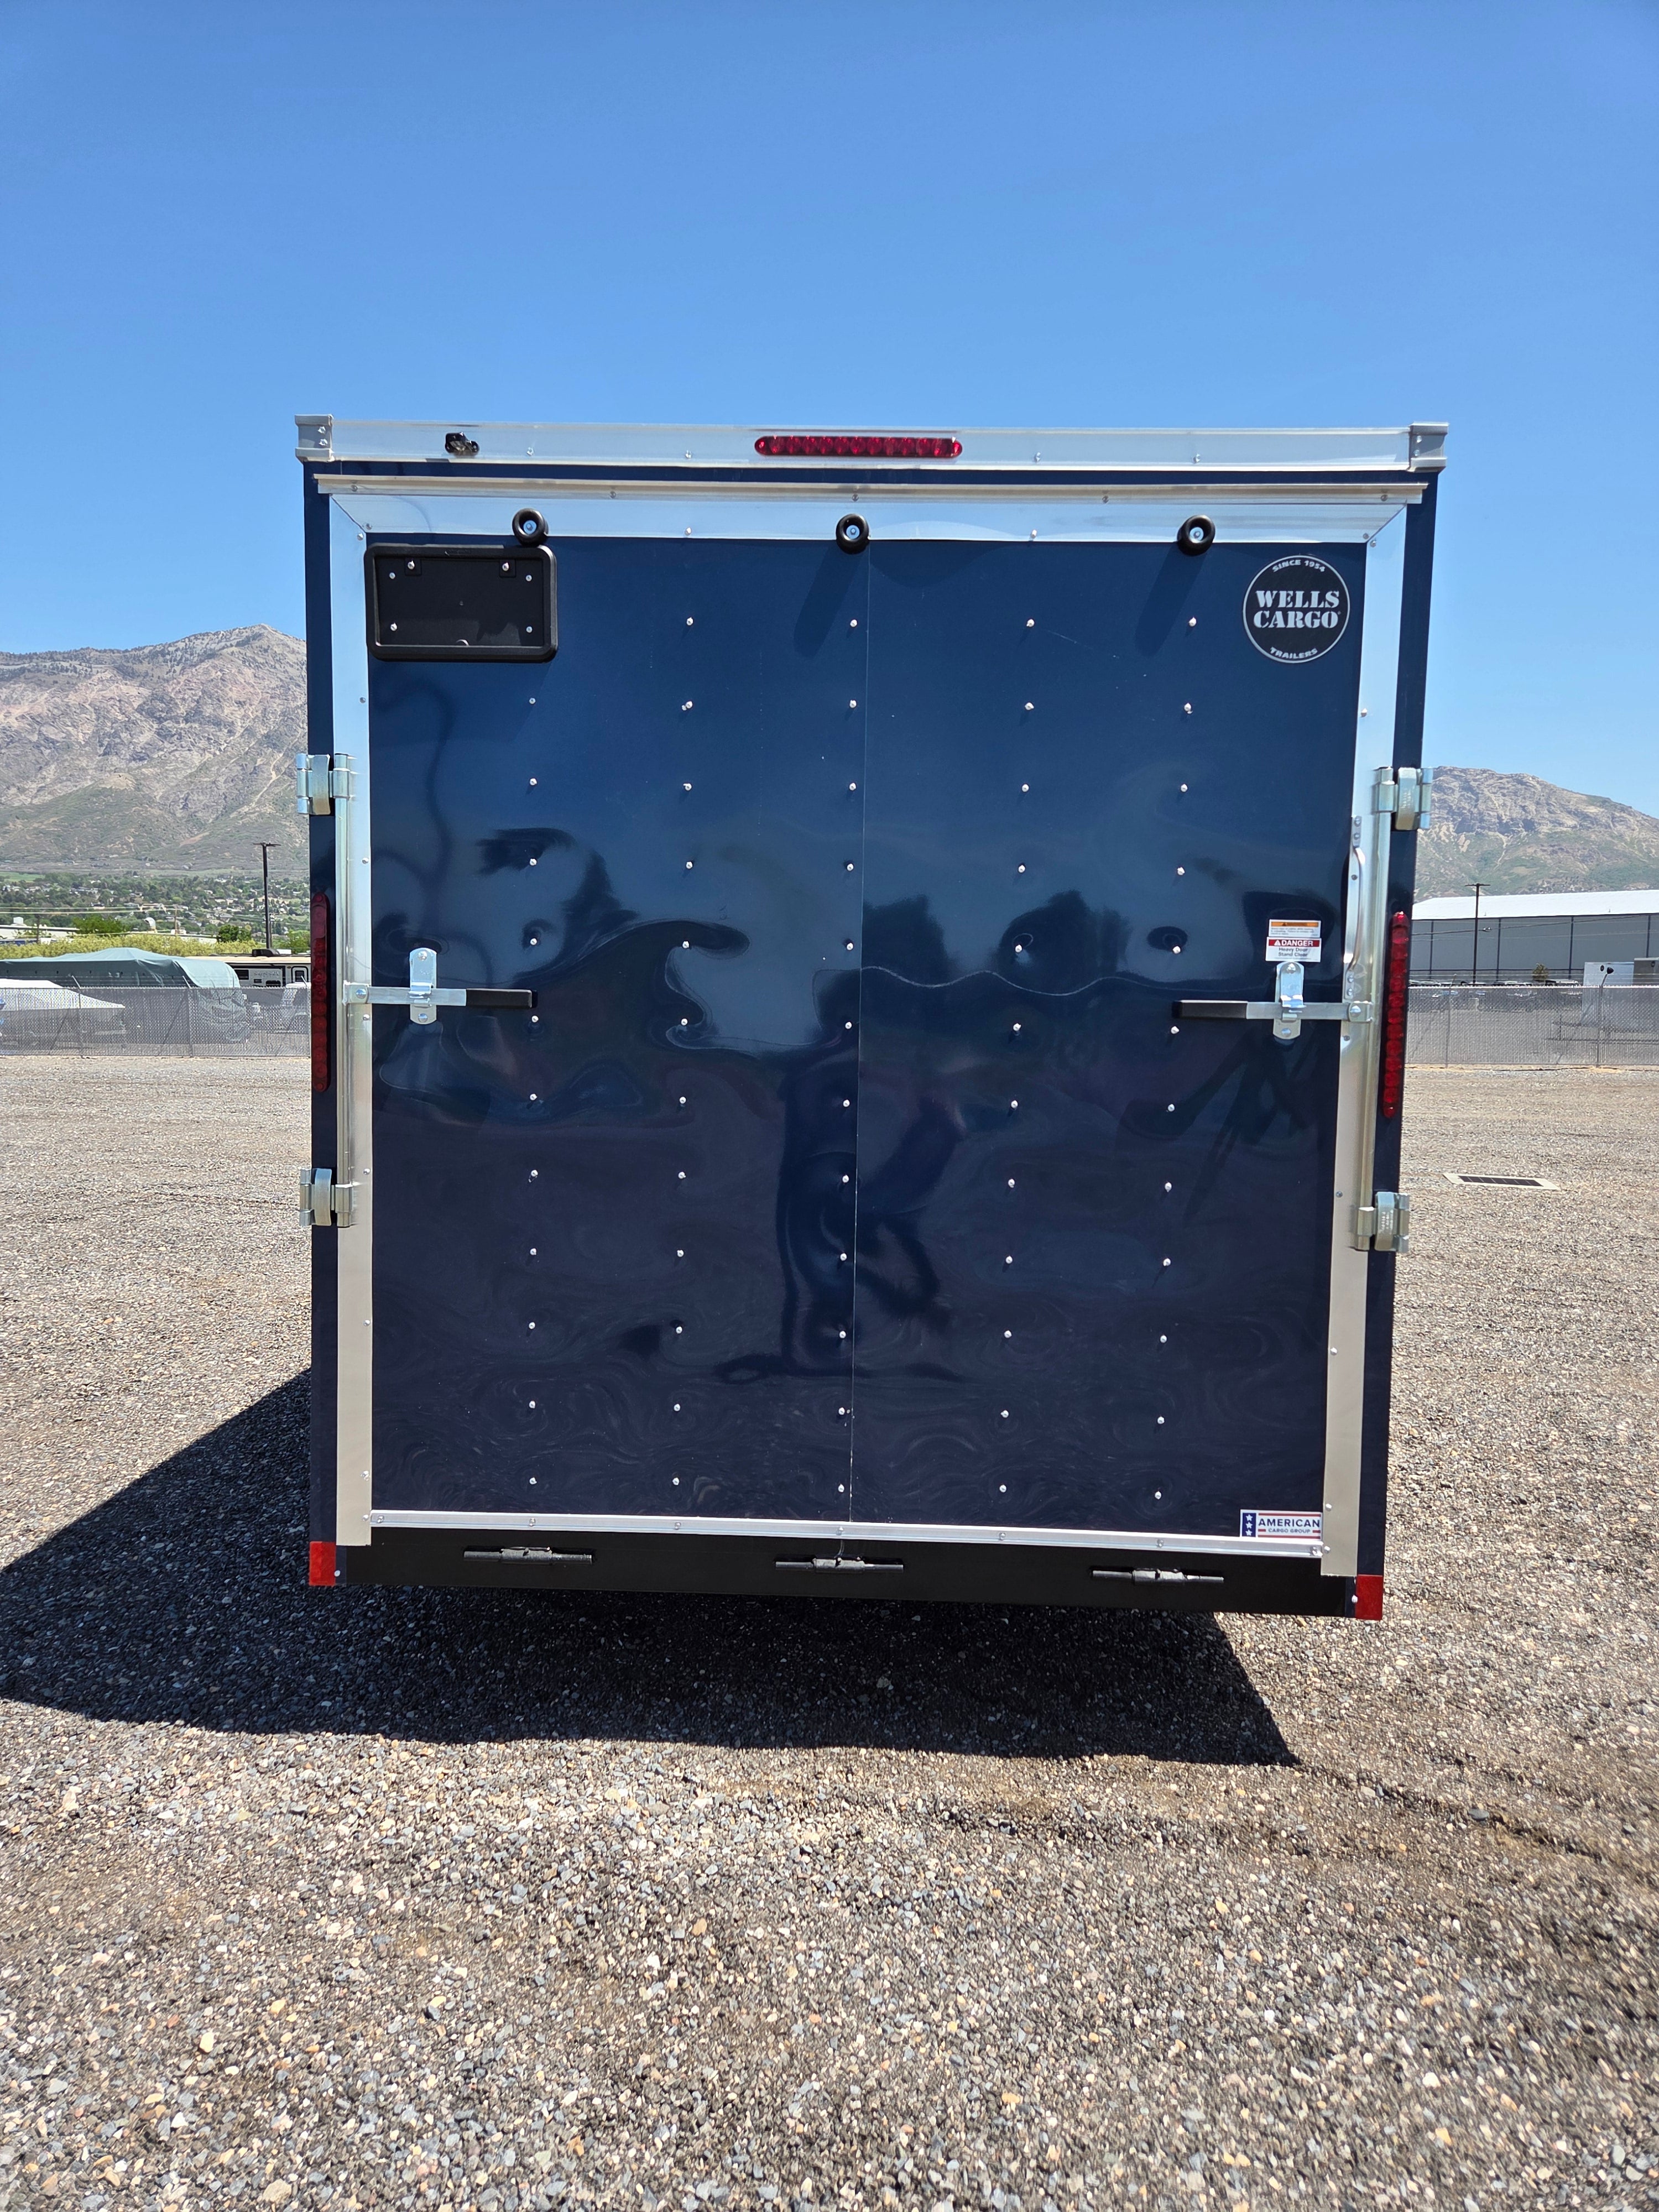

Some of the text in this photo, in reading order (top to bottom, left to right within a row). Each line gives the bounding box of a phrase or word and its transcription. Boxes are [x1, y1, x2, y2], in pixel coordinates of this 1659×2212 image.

[1272, 560, 1326, 572] SINCE 1954
[1255, 590, 1339, 608] WELLS
[1254, 610, 1338, 628] CARGO
[1270, 647, 1318, 659] TRAILERS
[1259, 1519, 1320, 1527] AMERICAN
